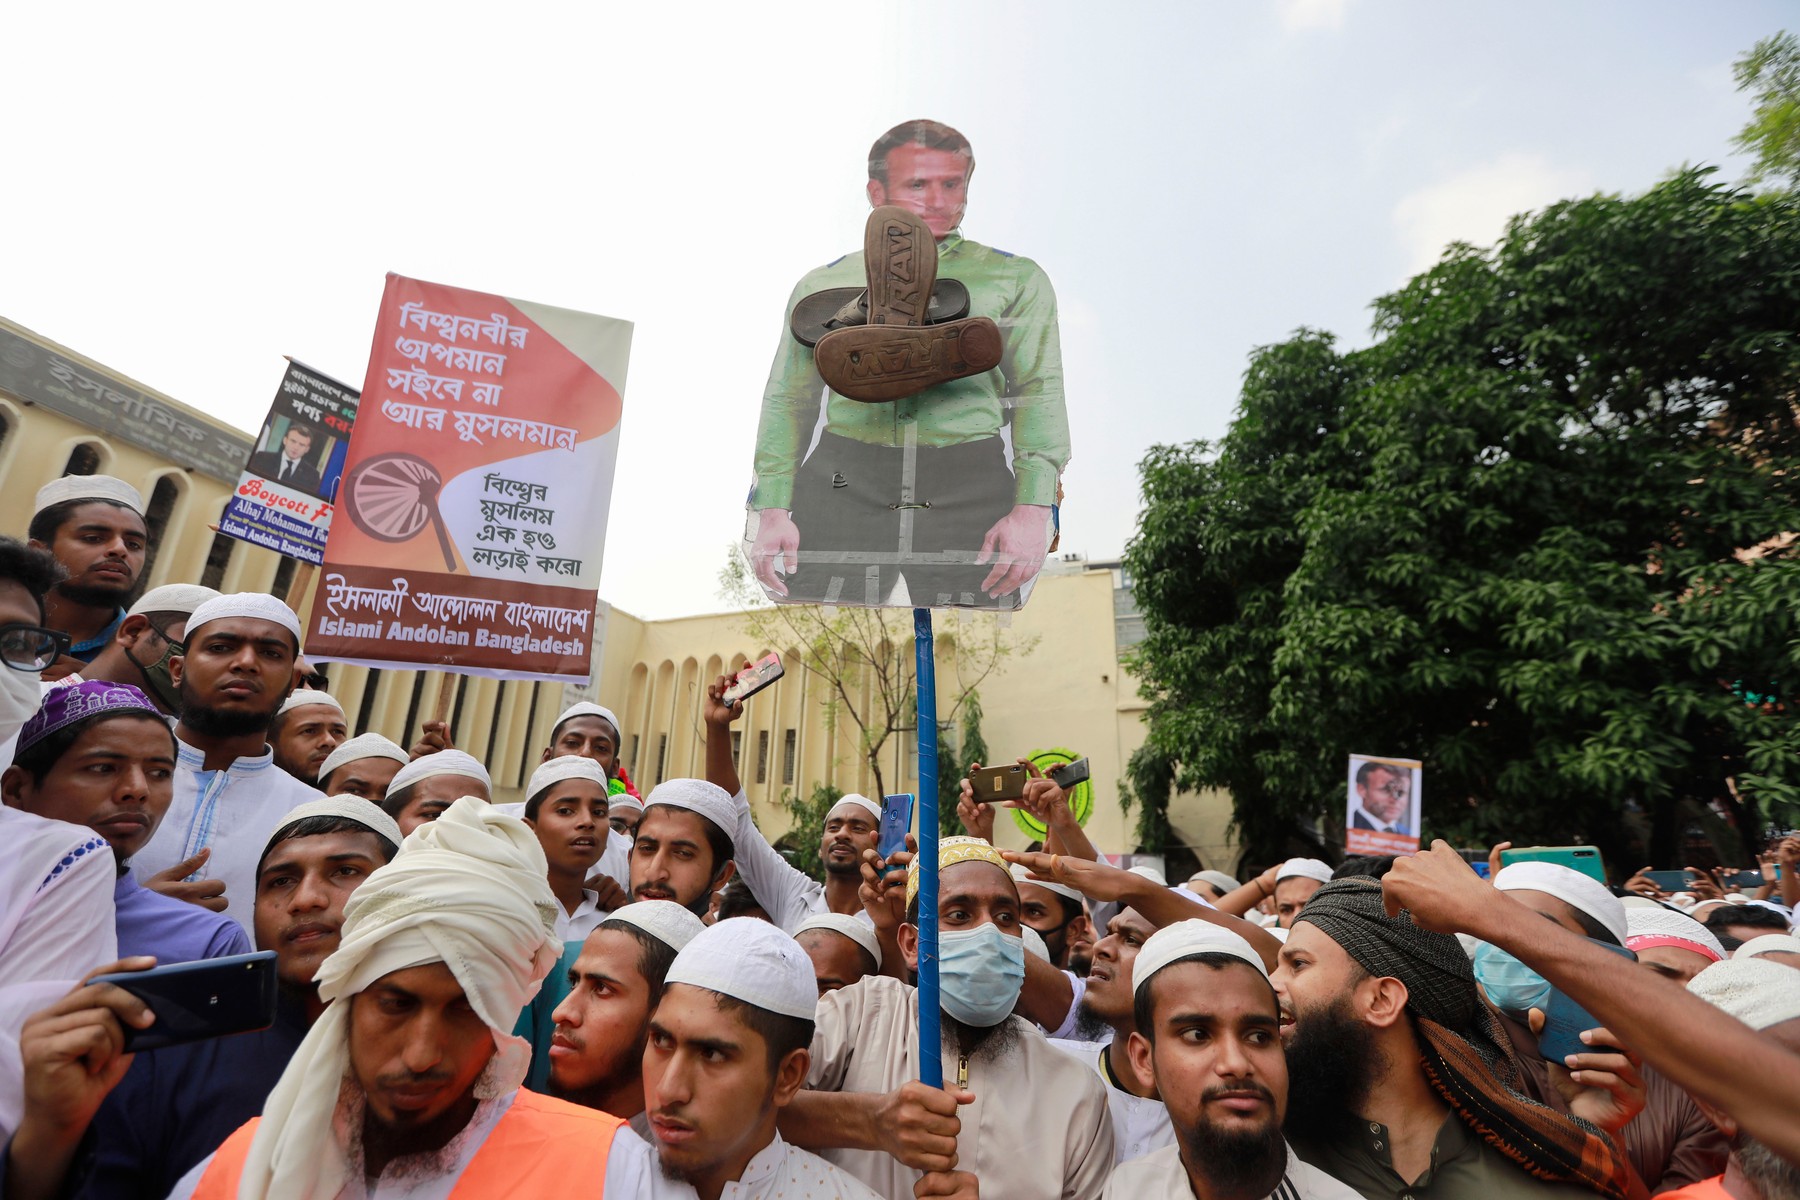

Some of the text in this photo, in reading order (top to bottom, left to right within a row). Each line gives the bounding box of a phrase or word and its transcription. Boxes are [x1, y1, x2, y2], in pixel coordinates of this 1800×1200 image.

[398, 301, 529, 349] বিশ্বনবীর
[394, 335, 507, 377] অপমান
[46, 355, 209, 443] ইসলামিক
[386, 366, 504, 407] সইবে না
[381, 398, 580, 452] আর মুসলমান
[238, 479, 309, 514] Boycott
[483, 472, 548, 504] বিশ্বের
[234, 499, 262, 522] Alhaj
[262, 510, 315, 538] Mohammad
[480, 498, 554, 526] মুসলিম
[222, 518, 246, 538] Islami
[248, 527, 280, 550] Andolan
[280, 539, 321, 564] Bangladesh
[476, 523, 557, 551] এক হও
[472, 545, 583, 577] লড়াই করো
[326, 573, 592, 635] ইসলামী আন্দোলন বাংলাদেশ
[318, 616, 584, 657] Islami Andolan Bangladesh
